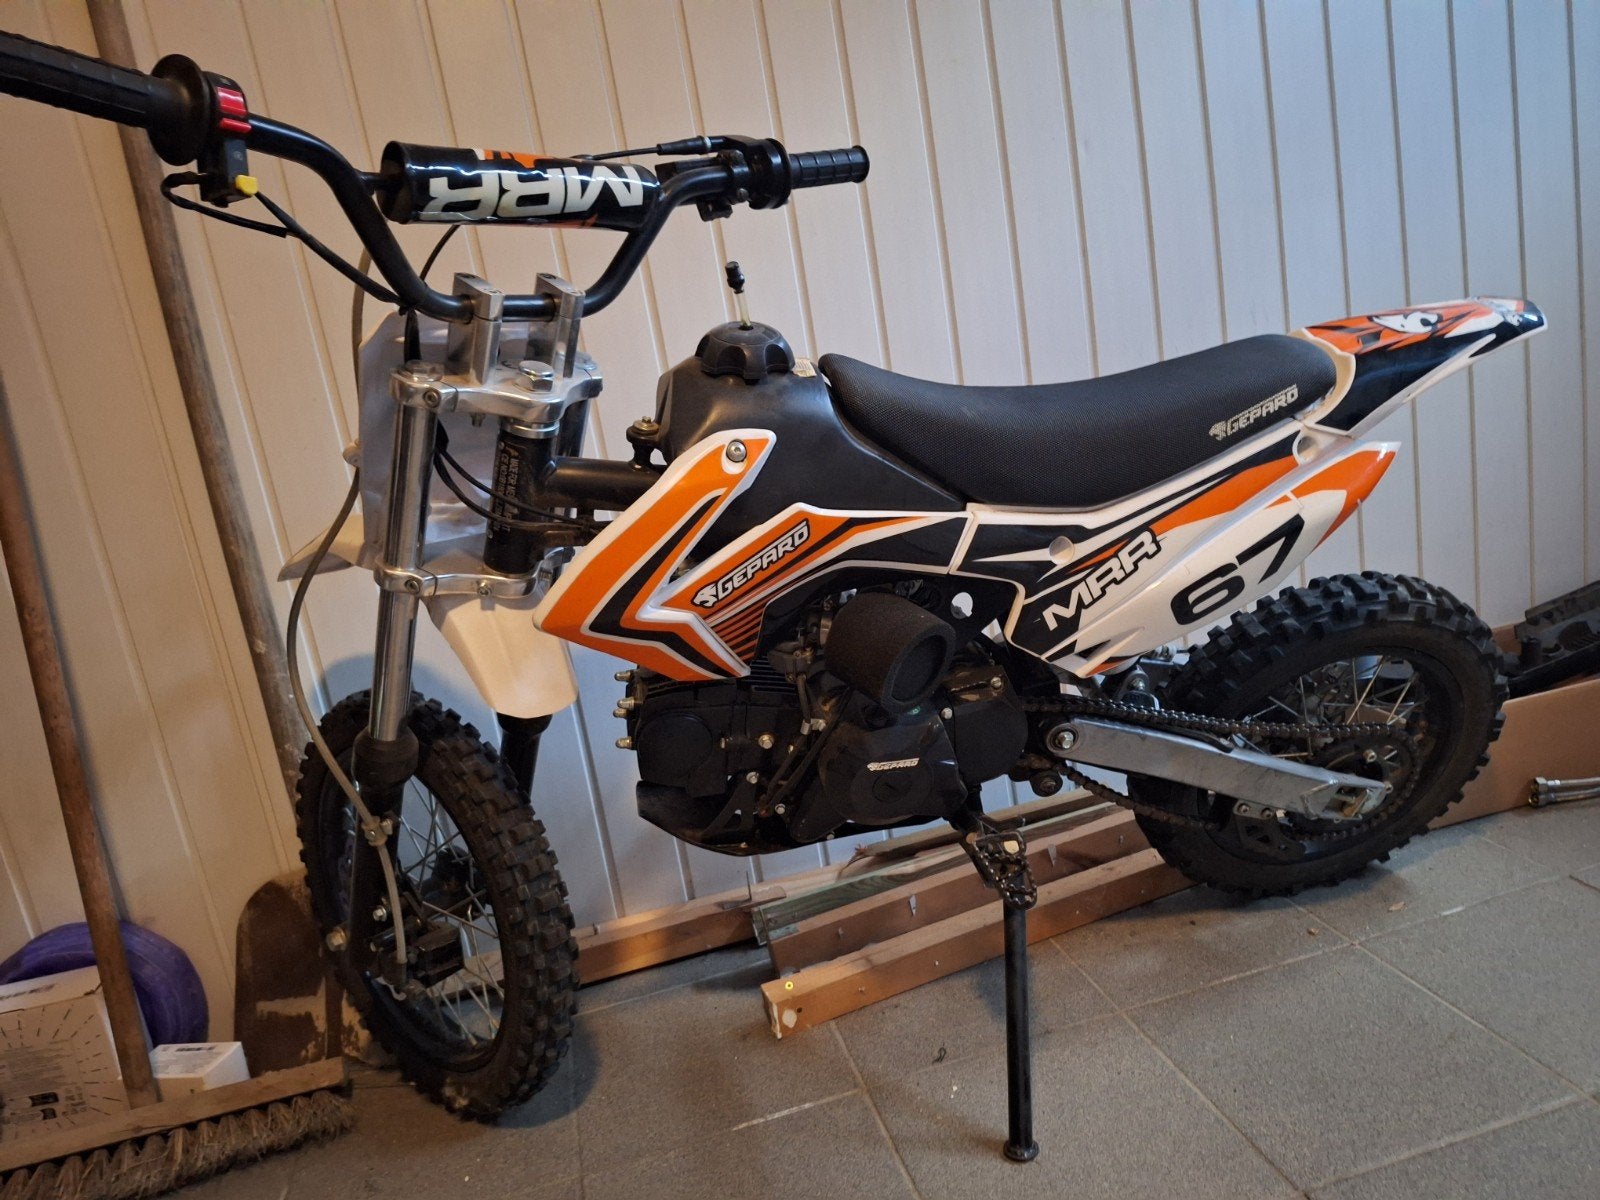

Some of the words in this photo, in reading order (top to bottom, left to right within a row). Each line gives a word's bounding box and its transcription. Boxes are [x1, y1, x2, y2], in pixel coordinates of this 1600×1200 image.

[418, 165, 643, 221] MRR
[1227, 383, 1298, 436] GEPARD
[717, 519, 809, 601] GEPARD
[1042, 529, 1160, 631] MRR
[1170, 513, 1305, 625] 67
